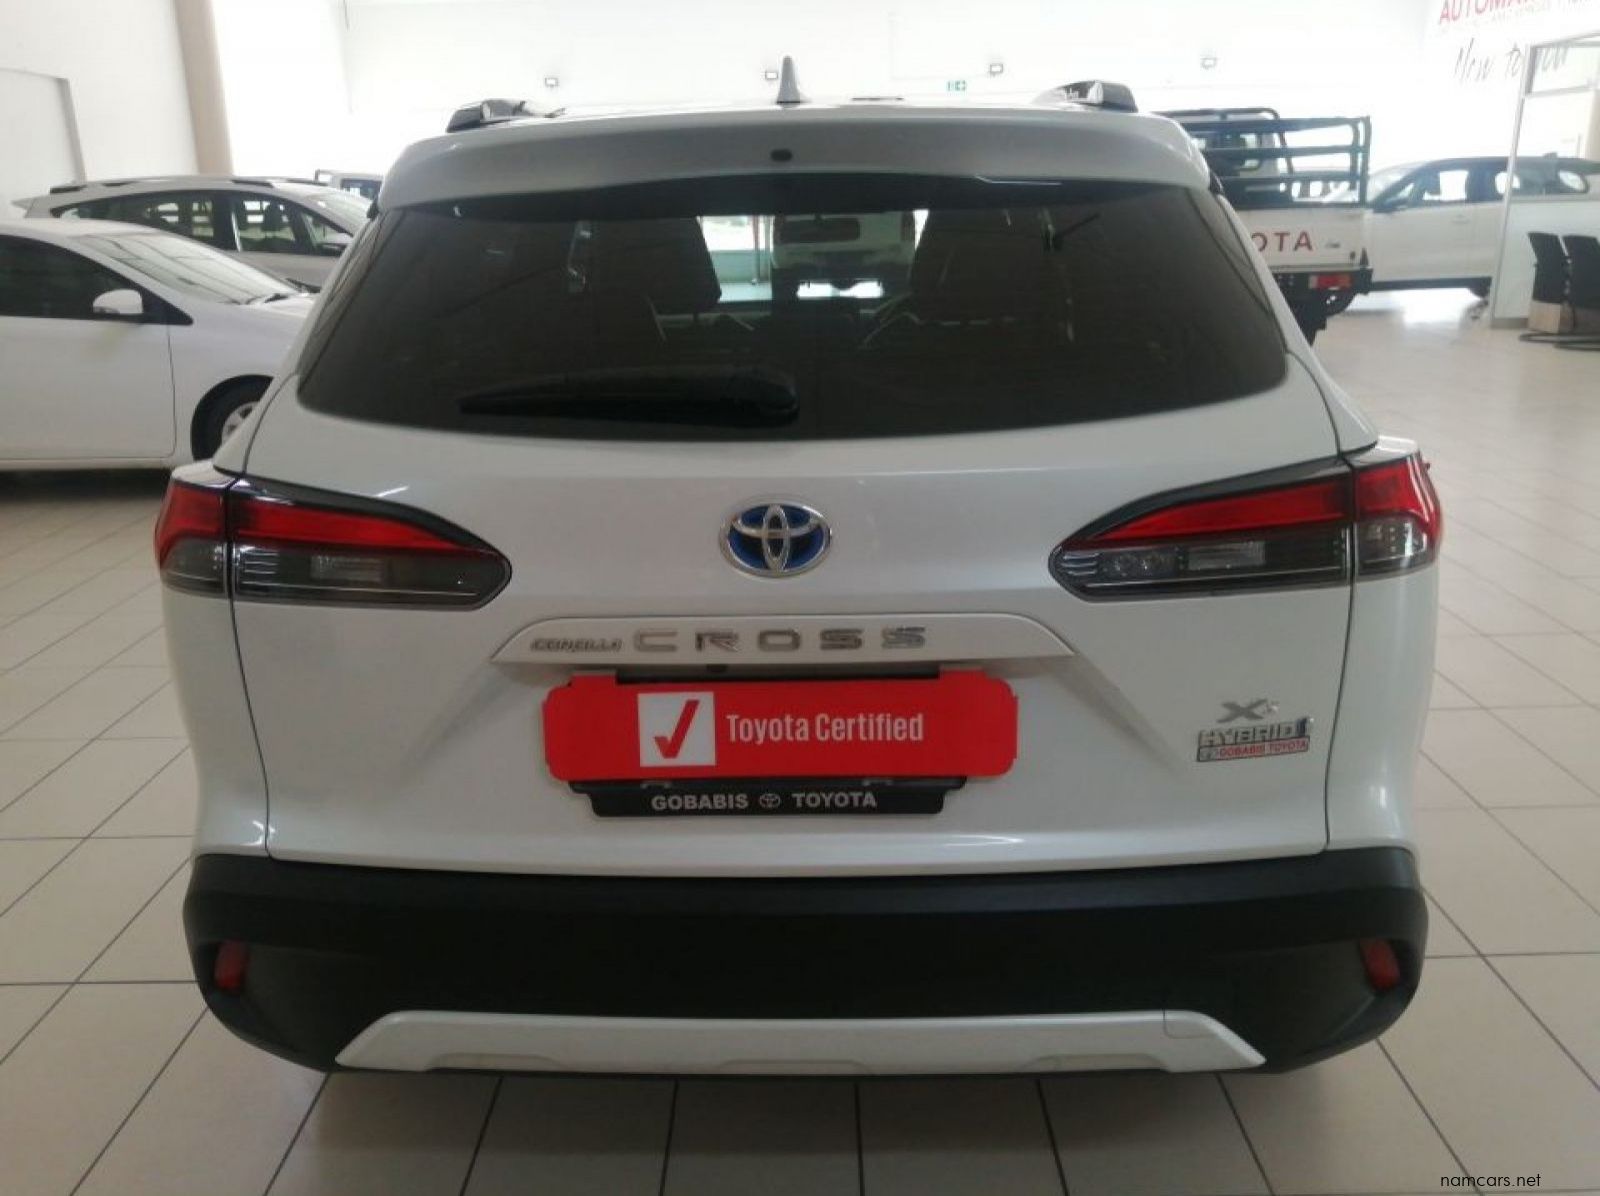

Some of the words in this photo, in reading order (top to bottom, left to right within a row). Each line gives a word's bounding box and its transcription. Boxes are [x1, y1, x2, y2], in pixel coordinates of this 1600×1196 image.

[1251, 230, 1314, 252] OTA
[633, 626, 926, 652] CROSS
[726, 713, 810, 745] Toyota
[814, 712, 924, 742] Certified
[1198, 721, 1302, 748] HYBRID
[651, 793, 749, 811] GOBABIS
[791, 791, 878, 808] TOYOTA
